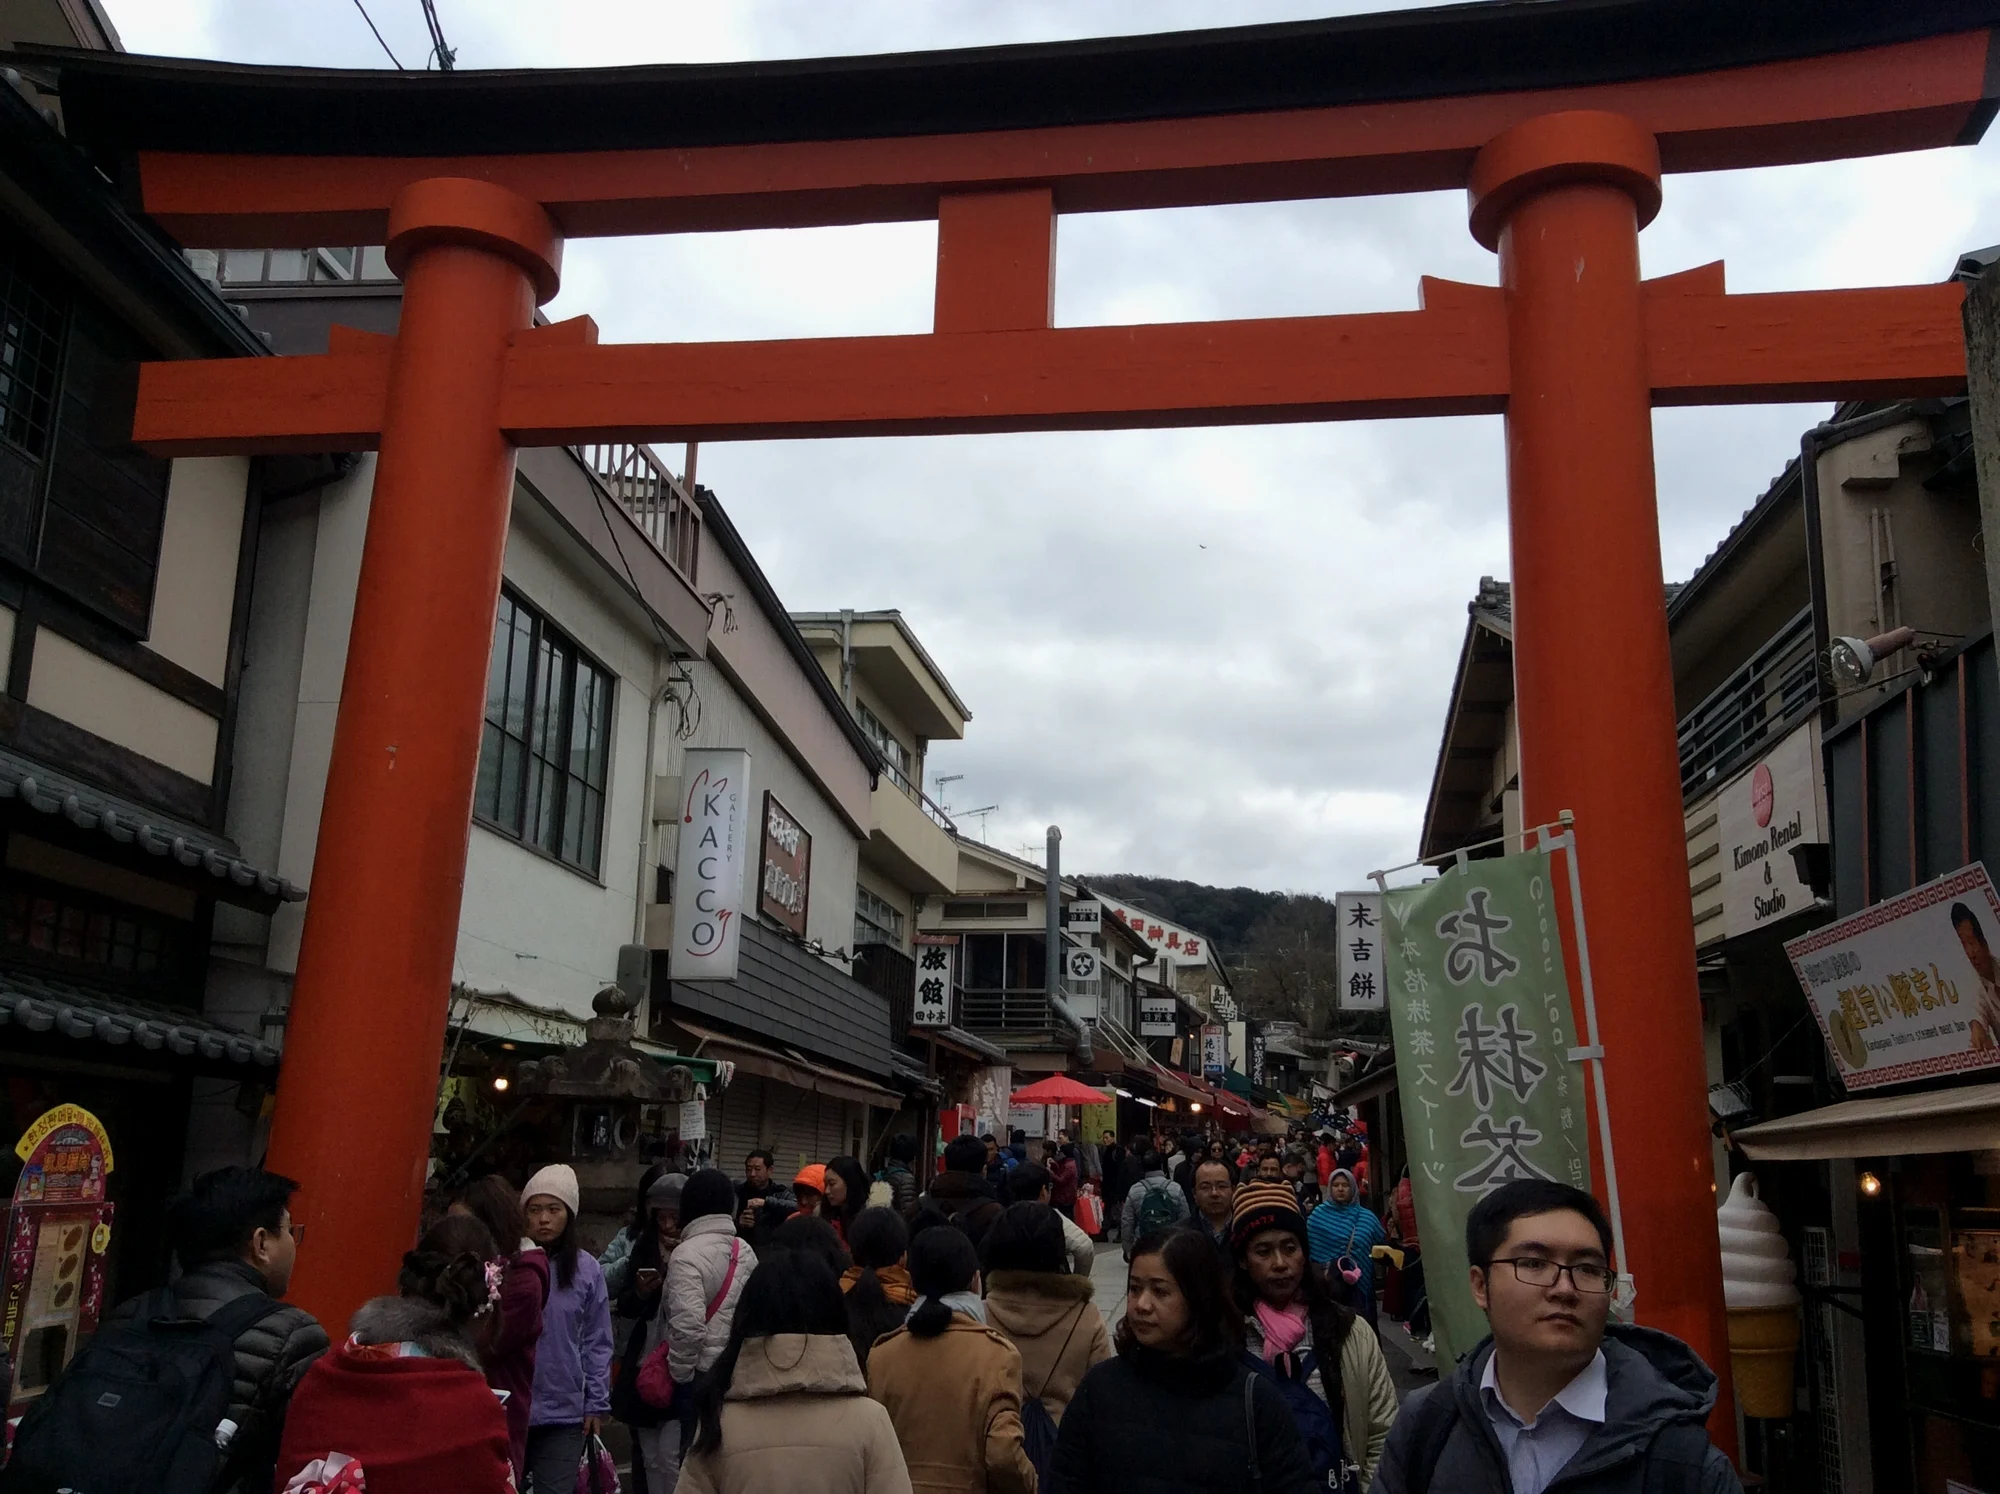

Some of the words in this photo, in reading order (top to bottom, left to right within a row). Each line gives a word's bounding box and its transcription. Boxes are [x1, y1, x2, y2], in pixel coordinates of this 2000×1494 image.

[726, 794, 737, 862] GALLERY
[1733, 840, 1769, 871] Kimono
[1770, 811, 1802, 851] Rental
[691, 793, 720, 946] KACCO
[1763, 861, 1773, 885] &
[1754, 888, 1786, 920] Studio
[920, 945, 947, 1005] 旅館
[1347, 902, 1376, 999] 末吉餅
[915, 1010, 946, 1023] 田中亭
[1836, 962, 1959, 1030] 超旨い豚まん
